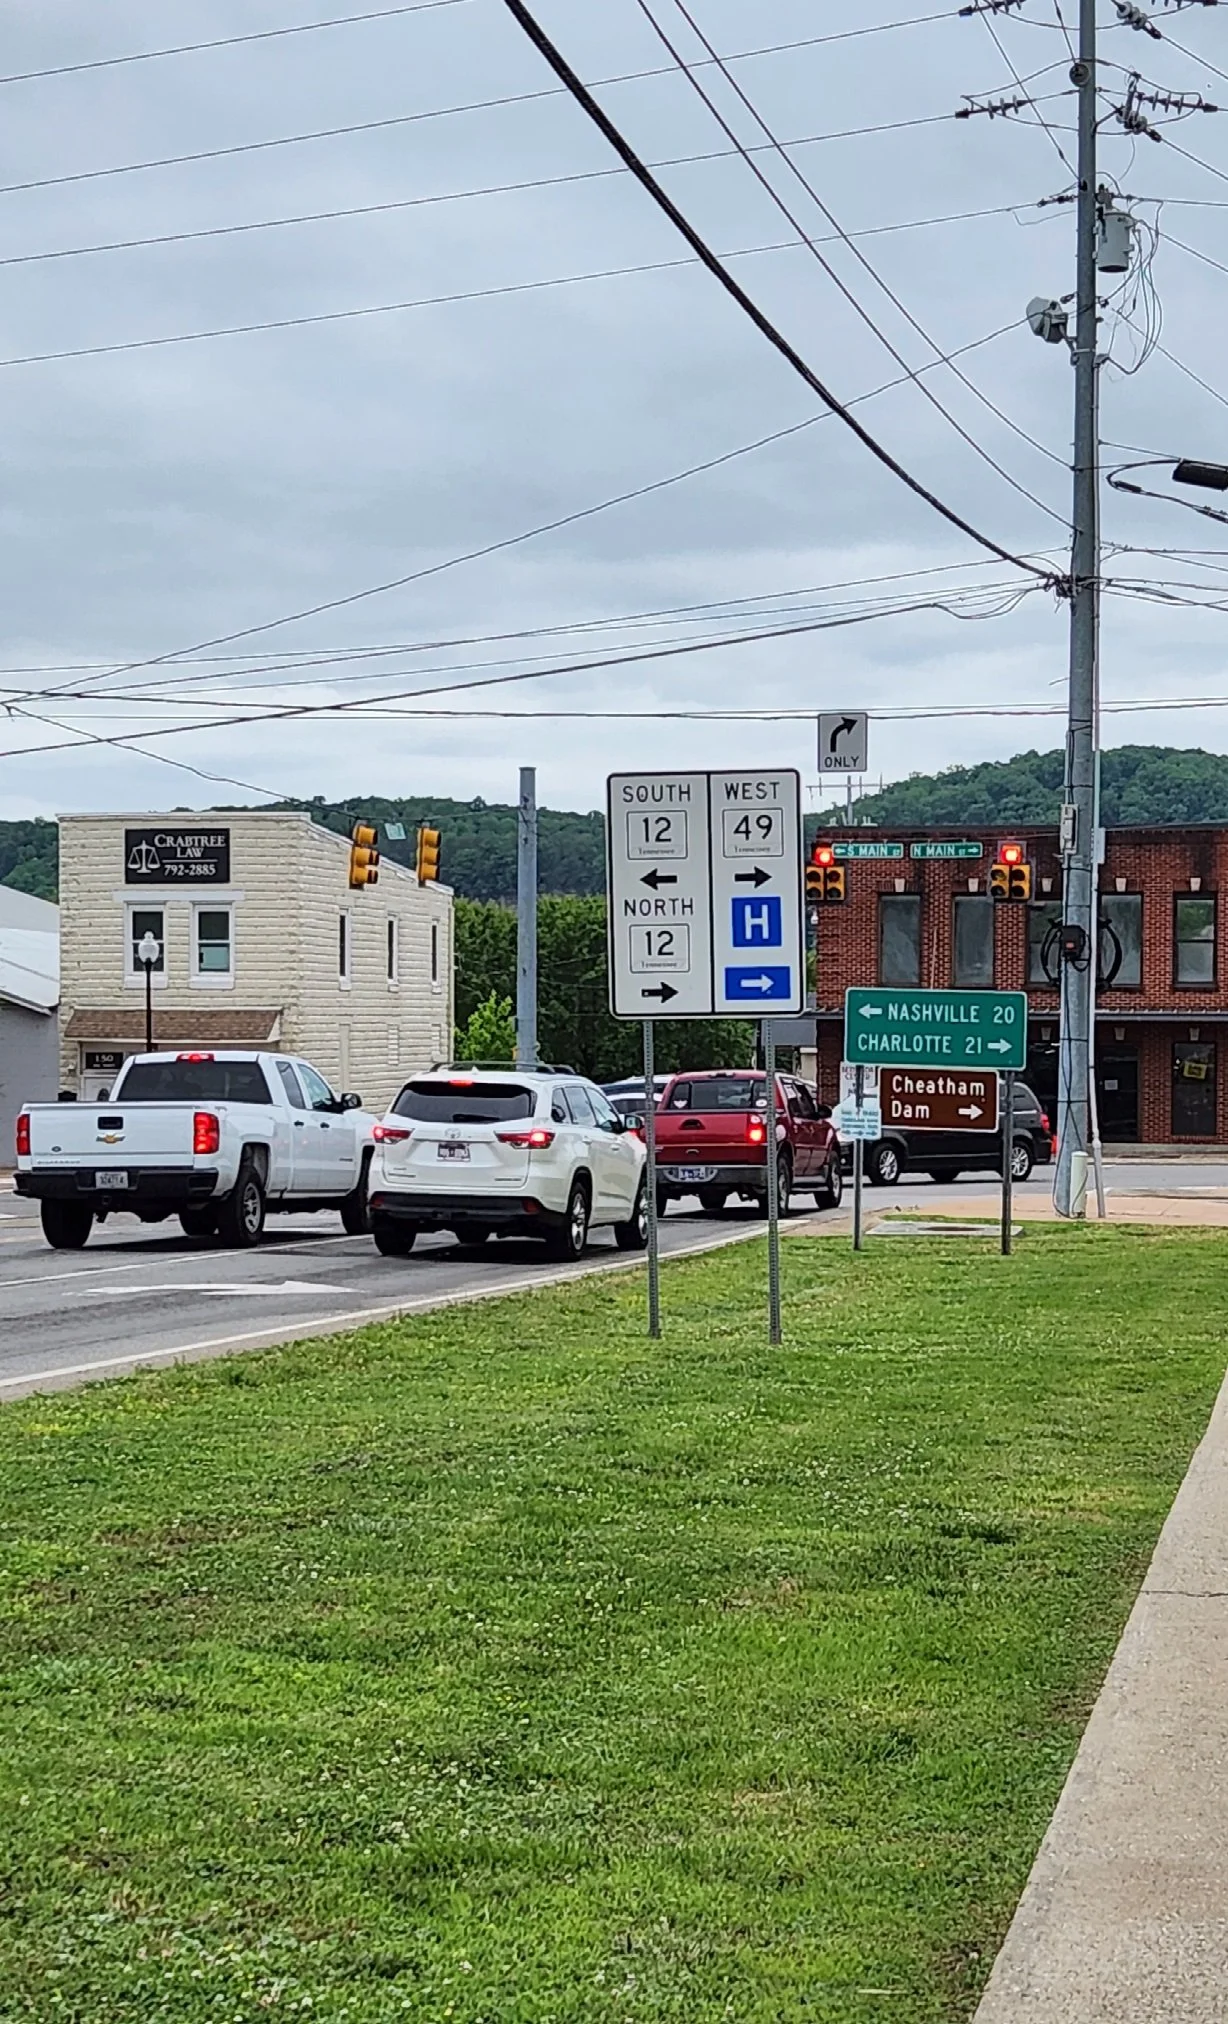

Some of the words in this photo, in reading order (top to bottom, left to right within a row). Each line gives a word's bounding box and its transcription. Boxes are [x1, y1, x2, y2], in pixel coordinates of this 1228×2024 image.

[824, 755, 860, 768] ONLY
[622, 783, 692, 803] SOUTH
[724, 781, 781, 800] WEST
[642, 816, 672, 843] 12
[733, 814, 773, 840] 49
[176, 847, 204, 858] LAW
[847, 844, 854, 857] S
[859, 844, 888, 857] MAIN
[913, 845, 921, 857] N
[927, 843, 955, 857] MAIN
[164, 864, 216, 876] 792-2885
[624, 897, 694, 917] NORTH
[744, 904, 769, 940] H
[645, 930, 675, 956] 12
[888, 1003, 980, 1023] NASHVILLE
[993, 1006, 1015, 1024] 20
[858, 1033, 952, 1054] CHARLOTTE
[965, 1036, 982, 1054] 21
[892, 1075, 985, 1096] Cheatham
[891, 1101, 930, 1119] Dam
